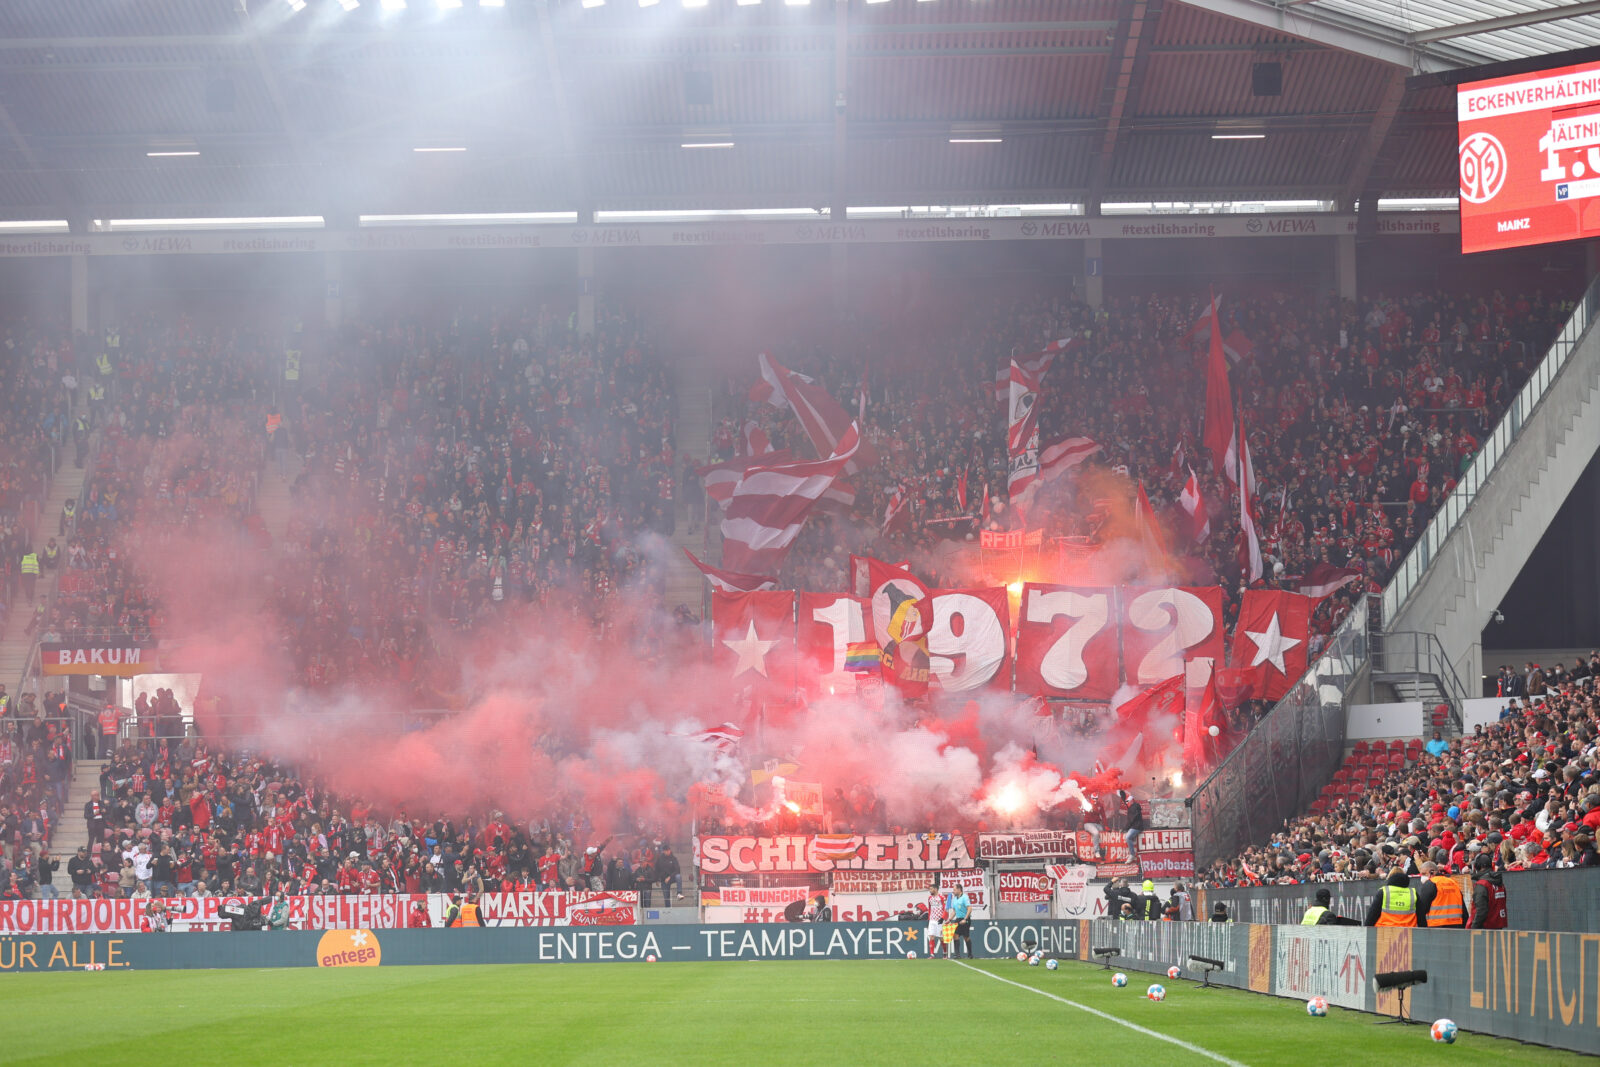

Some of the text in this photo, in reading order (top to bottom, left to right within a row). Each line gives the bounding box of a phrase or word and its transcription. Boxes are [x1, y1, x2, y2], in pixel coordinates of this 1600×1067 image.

[1553, 121, 1600, 143] ÄLTNI
[1042, 222, 1091, 237] MEWA
[1122, 222, 1216, 237] #textilsharing
[1266, 218, 1316, 233] MEWA
[1347, 219, 1440, 234] #ilsharing
[1498, 218, 1530, 232] MAINZ
[448, 234, 540, 247] #textilsharing
[591, 229, 642, 244] MEWA
[815, 226, 866, 240] MEWA
[898, 226, 991, 241] #textilsharing
[0, 240, 92, 256] #textilsharing
[141, 237, 192, 251] MEWA
[223, 237, 315, 251] #textilsharing
[59, 647, 141, 665] BAKUM
[1138, 831, 1192, 851] COLEGIO
[961, 868, 983, 878] SIND
[834, 879, 933, 893] IMMER BEI UNS
[963, 877, 984, 887] DIR
[1000, 873, 1054, 891] SÜDTIROL
[722, 890, 746, 902] RED
[0, 899, 147, 931] ROHRDORF
[48, 939, 131, 968] ALLE.
[539, 932, 662, 960] ENTEGA
[322, 947, 376, 967] entega
